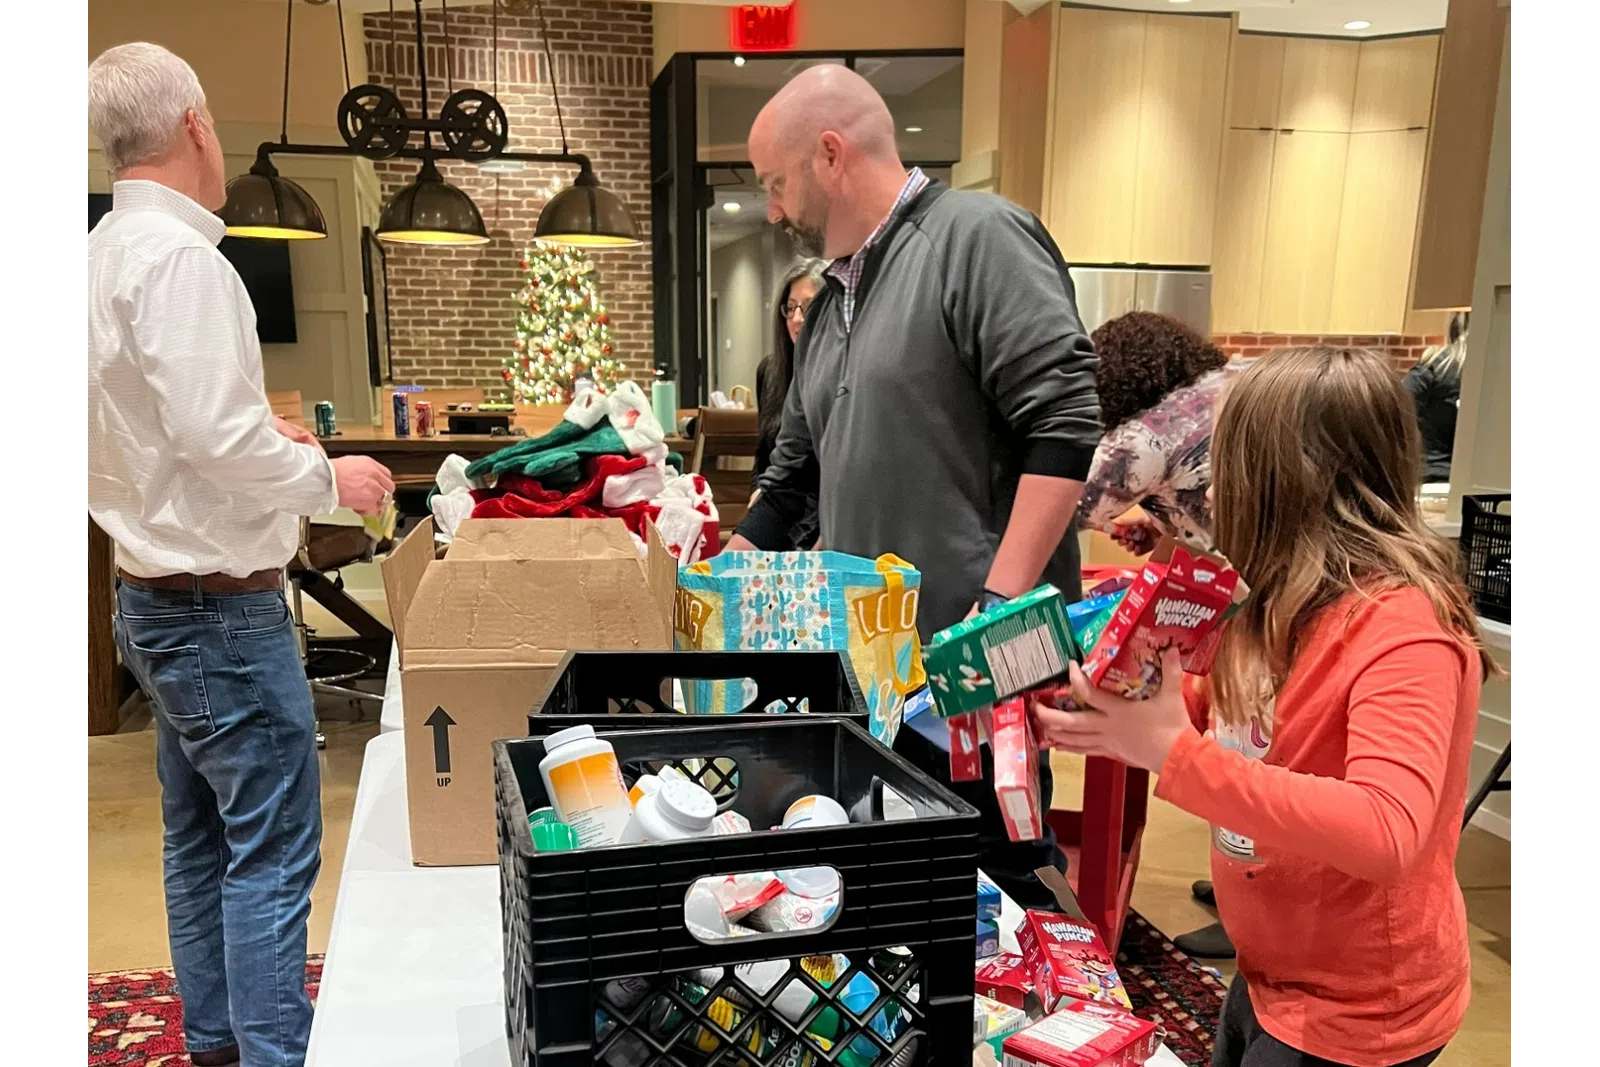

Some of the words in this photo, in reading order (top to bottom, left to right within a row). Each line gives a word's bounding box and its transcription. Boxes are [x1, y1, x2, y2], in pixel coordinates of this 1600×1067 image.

[1155, 597, 1217, 621] HAWAIIAN
[1155, 613, 1201, 628] PUNCH
[436, 777, 452, 788] UP
[1041, 922, 1096, 937] HAWAIIAN
[1055, 932, 1092, 943] PUNCH
